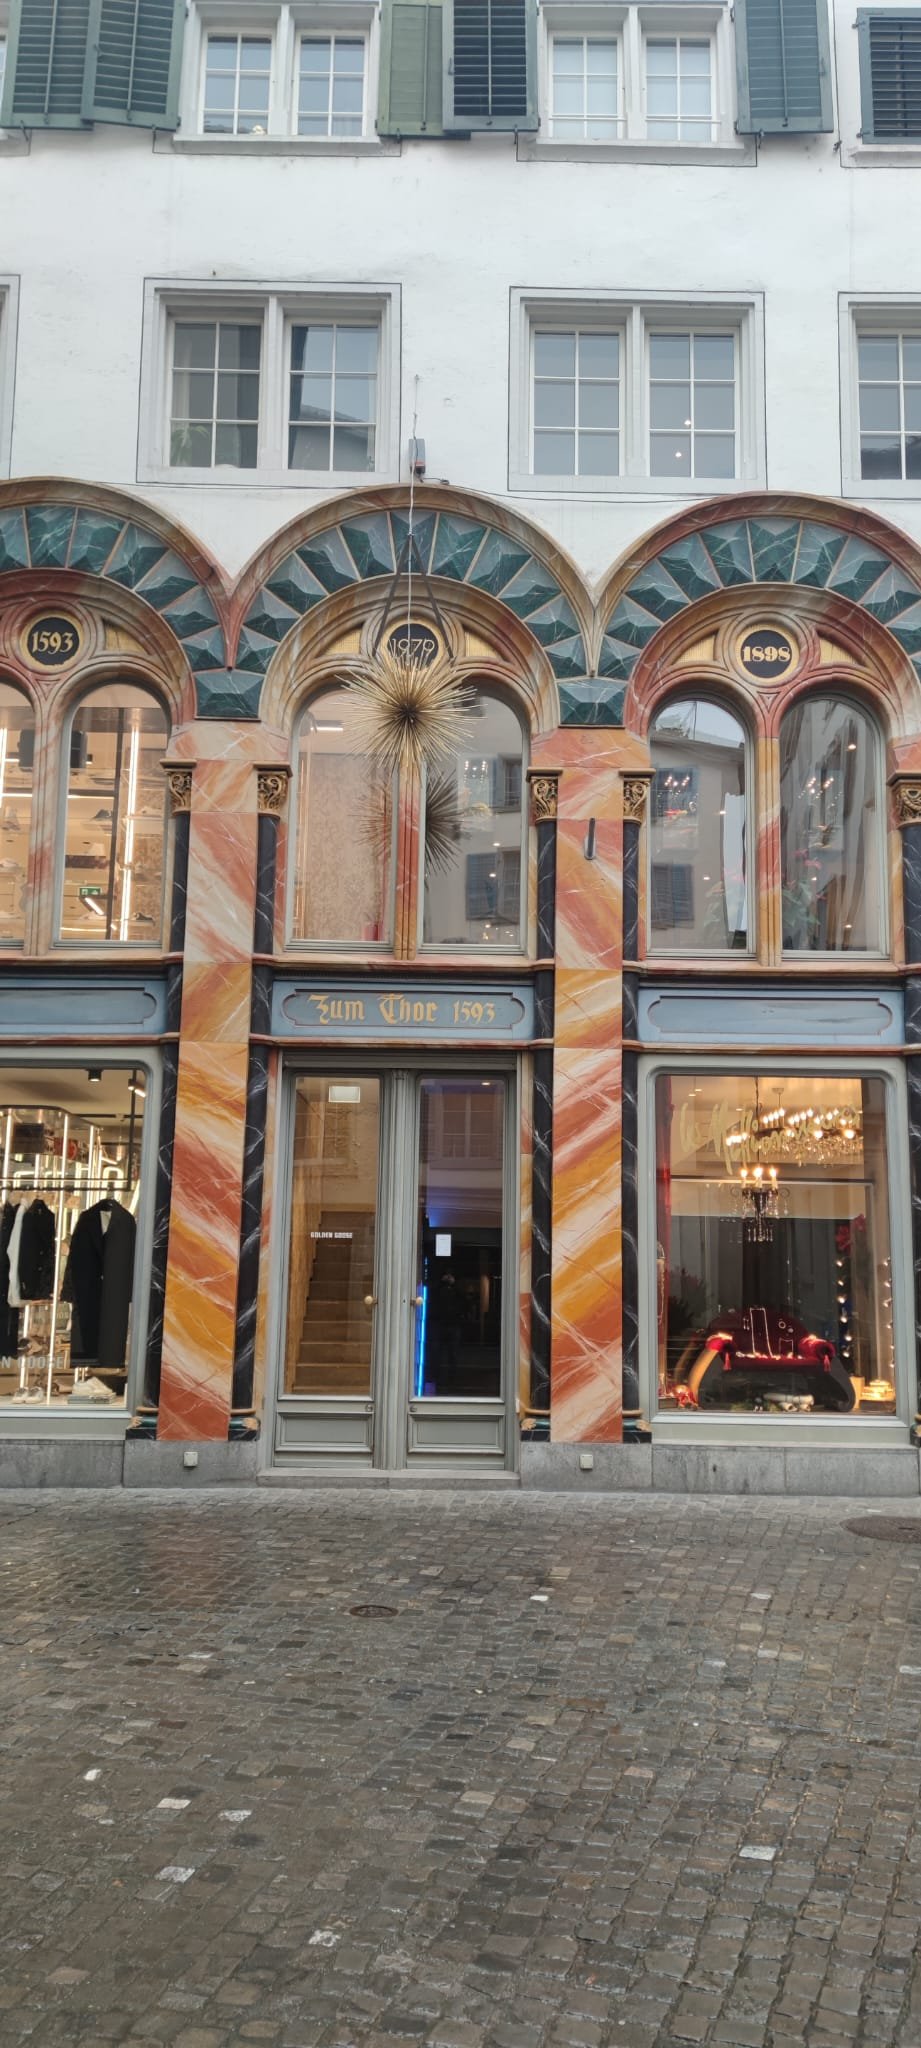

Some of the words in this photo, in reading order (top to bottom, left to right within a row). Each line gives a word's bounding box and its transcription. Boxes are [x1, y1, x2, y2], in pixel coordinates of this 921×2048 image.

[32, 630, 74, 654] 1593
[391, 638, 435, 659] 1979
[742, 645, 791, 662] 1898
[308, 993, 365, 1025] Zum
[377, 993, 438, 1025] Thor
[453, 1000, 496, 1025] 1593
[310, 1231, 333, 1239] GOLDEN
